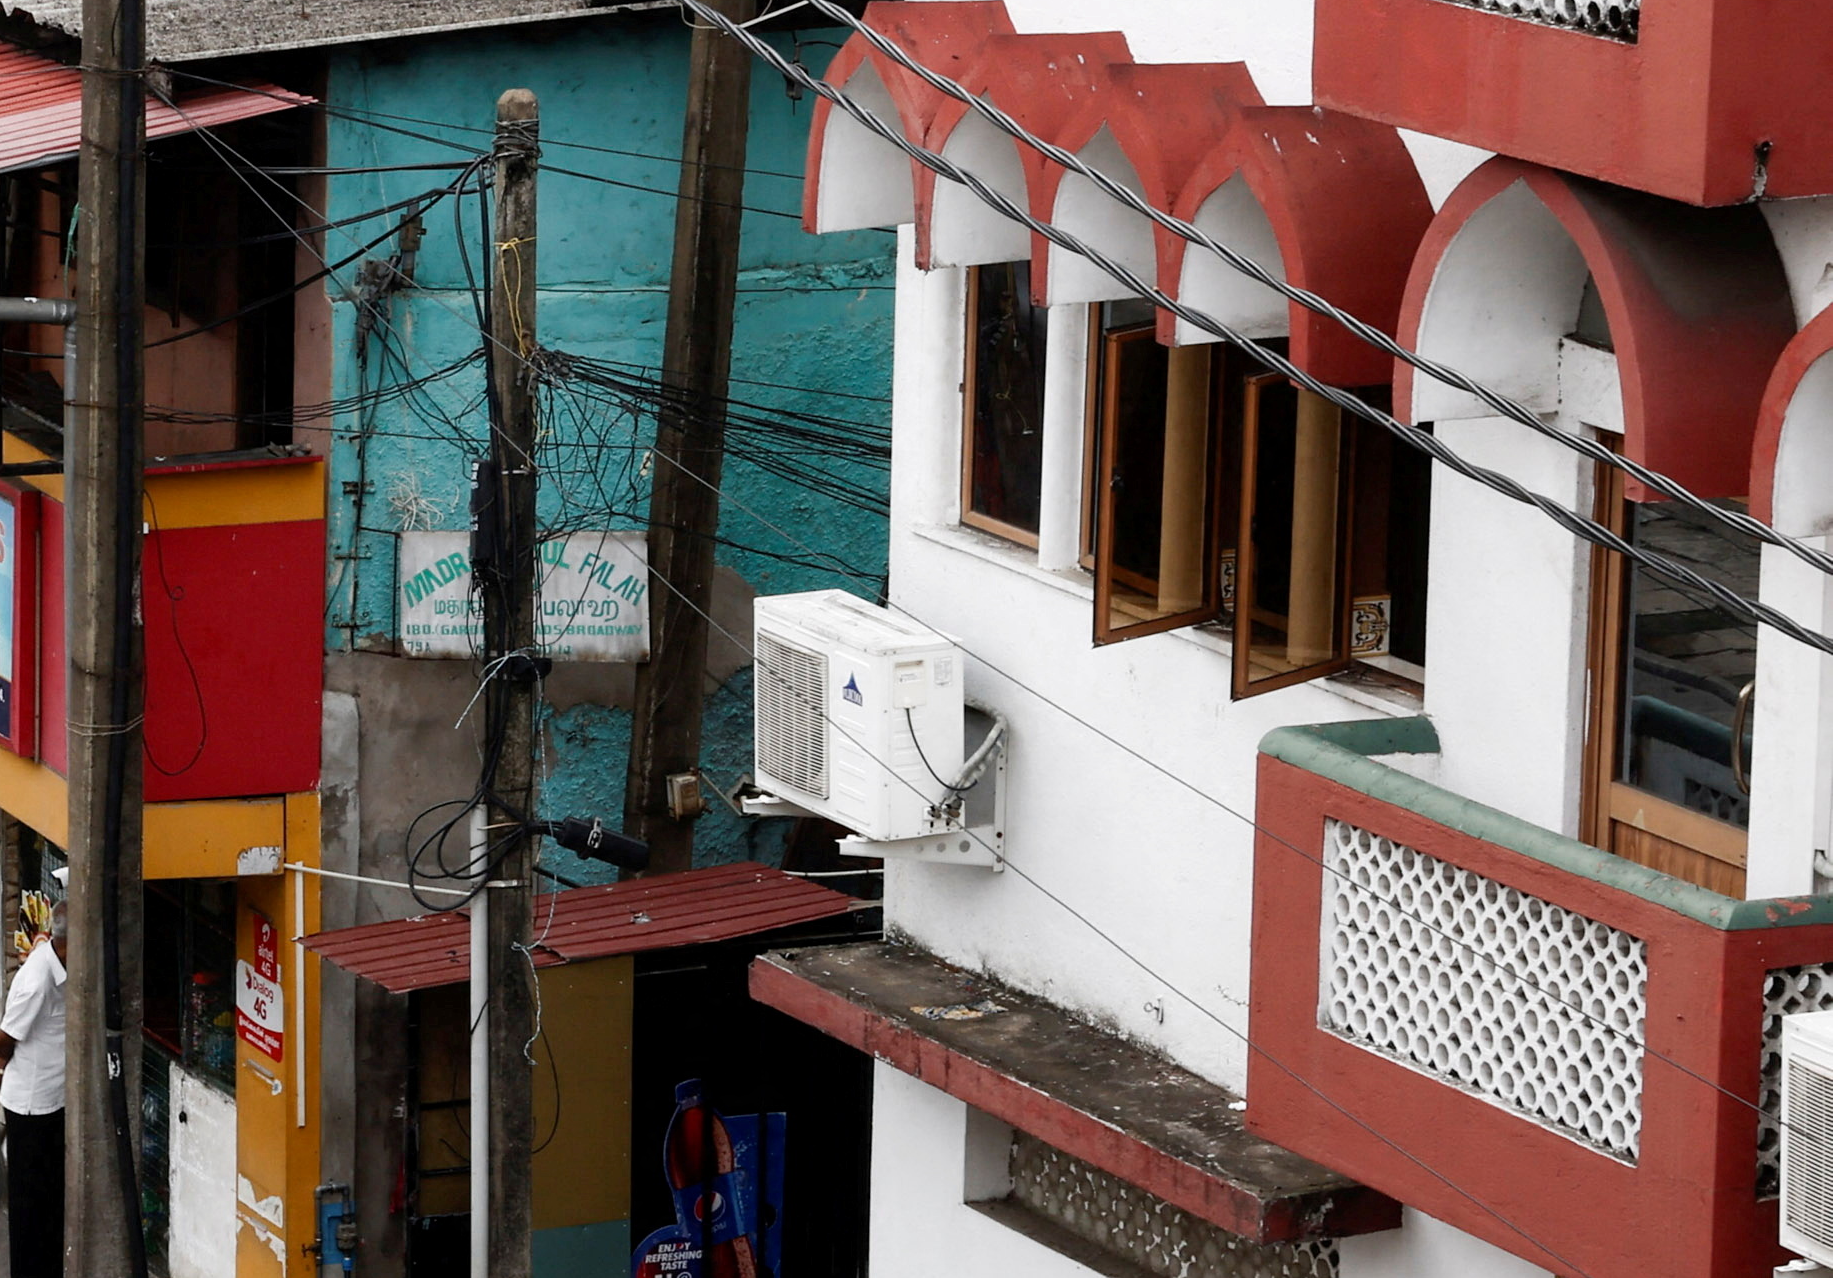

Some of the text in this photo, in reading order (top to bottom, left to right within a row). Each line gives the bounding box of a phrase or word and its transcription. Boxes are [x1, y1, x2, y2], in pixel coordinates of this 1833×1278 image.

[578, 552, 647, 607] FALAH
[261, 963, 271, 977] 4G
[252, 976, 274, 1003] Dialog
[253, 997, 267, 1020] 4G
[645, 1250, 703, 1263] REFRESHING
[661, 1261, 688, 1271] TASTE
